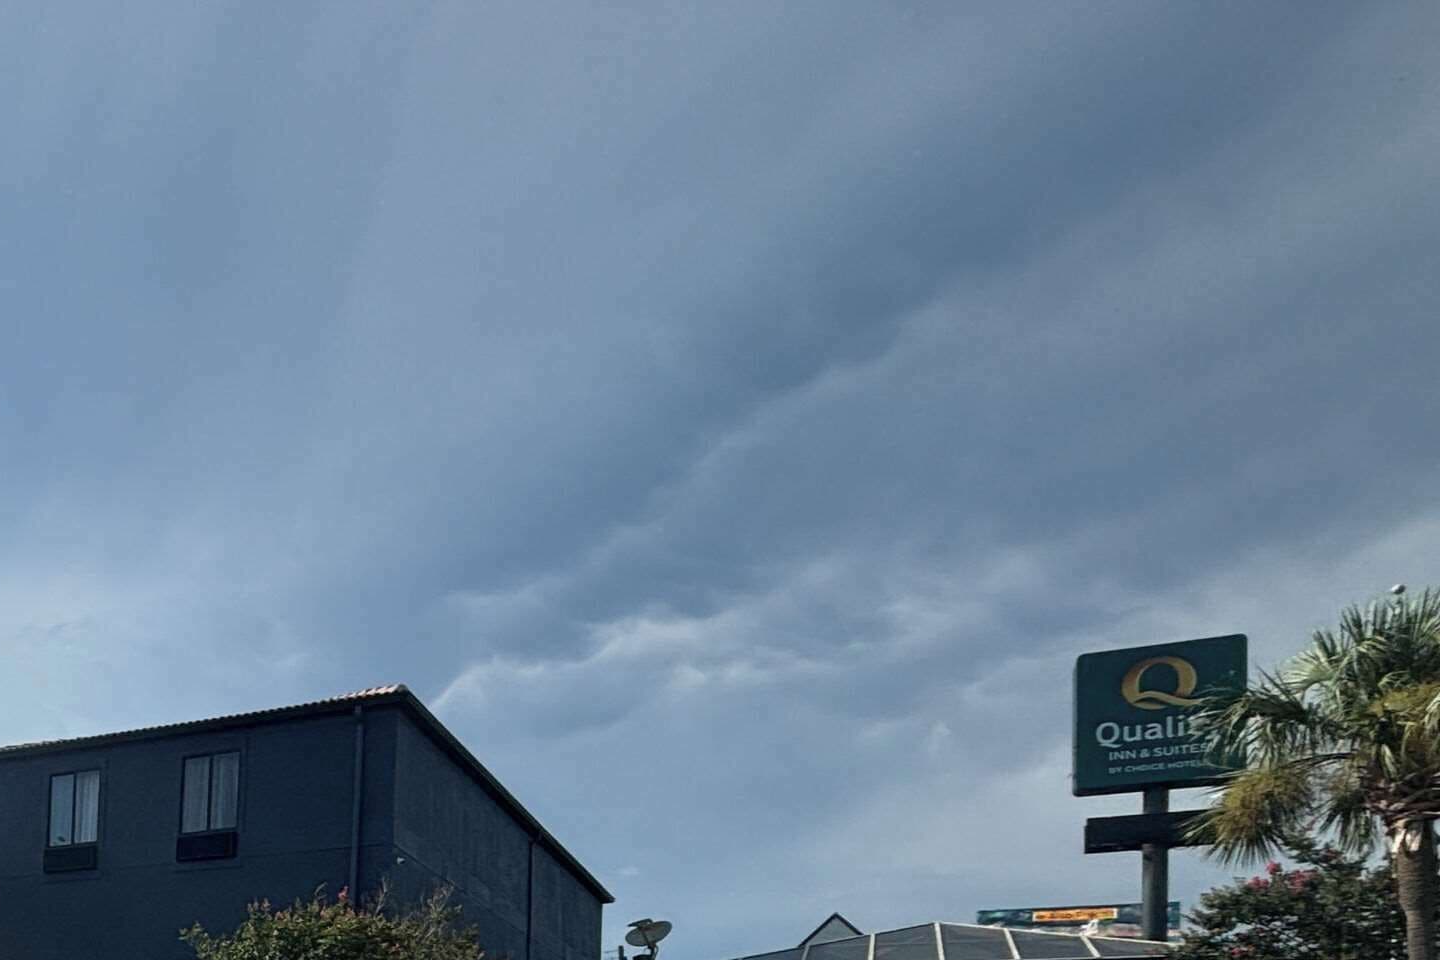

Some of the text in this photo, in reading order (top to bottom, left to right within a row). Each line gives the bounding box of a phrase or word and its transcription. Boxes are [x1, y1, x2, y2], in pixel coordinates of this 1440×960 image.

[1095, 715, 1198, 748] Quali
[1108, 743, 1209, 761] INN & SUITES
[1108, 766, 1122, 774] BY
[1125, 762, 1166, 773] CHOICE
